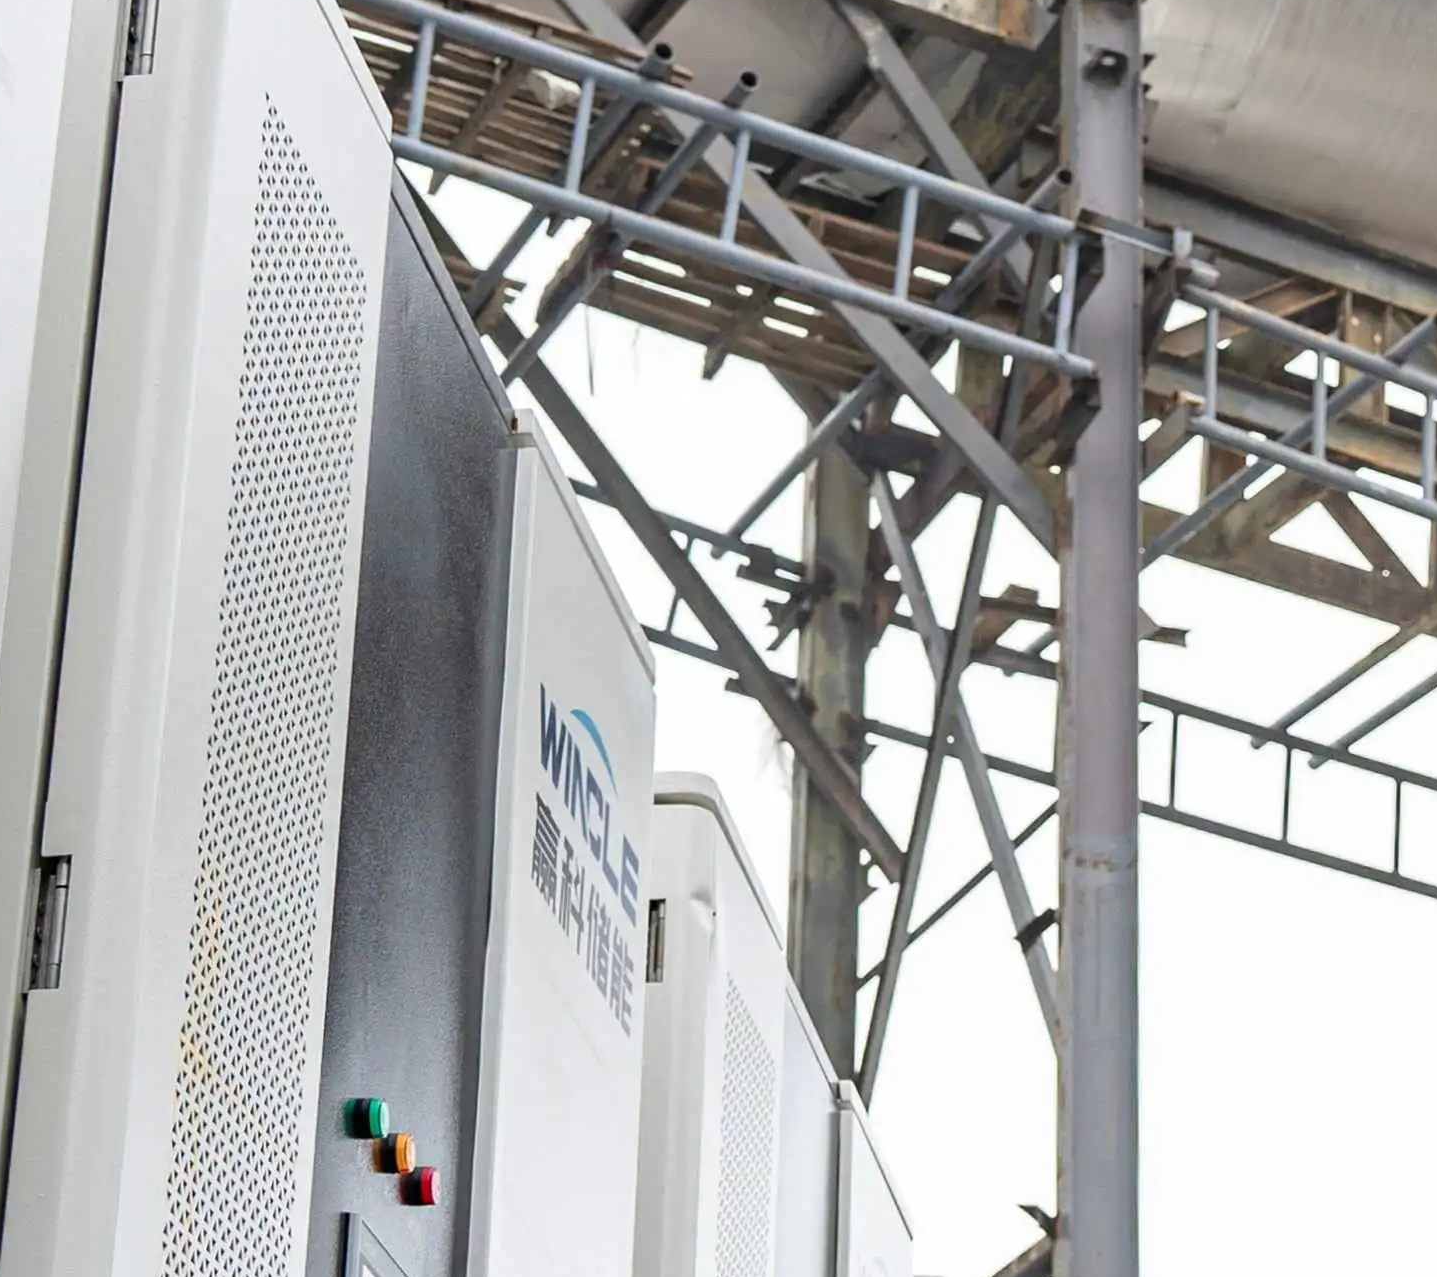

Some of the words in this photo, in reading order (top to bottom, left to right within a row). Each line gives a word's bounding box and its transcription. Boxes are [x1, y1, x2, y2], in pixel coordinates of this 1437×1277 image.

[530, 791, 635, 1038] 赢科储能
[539, 681, 640, 929] WINCLE
